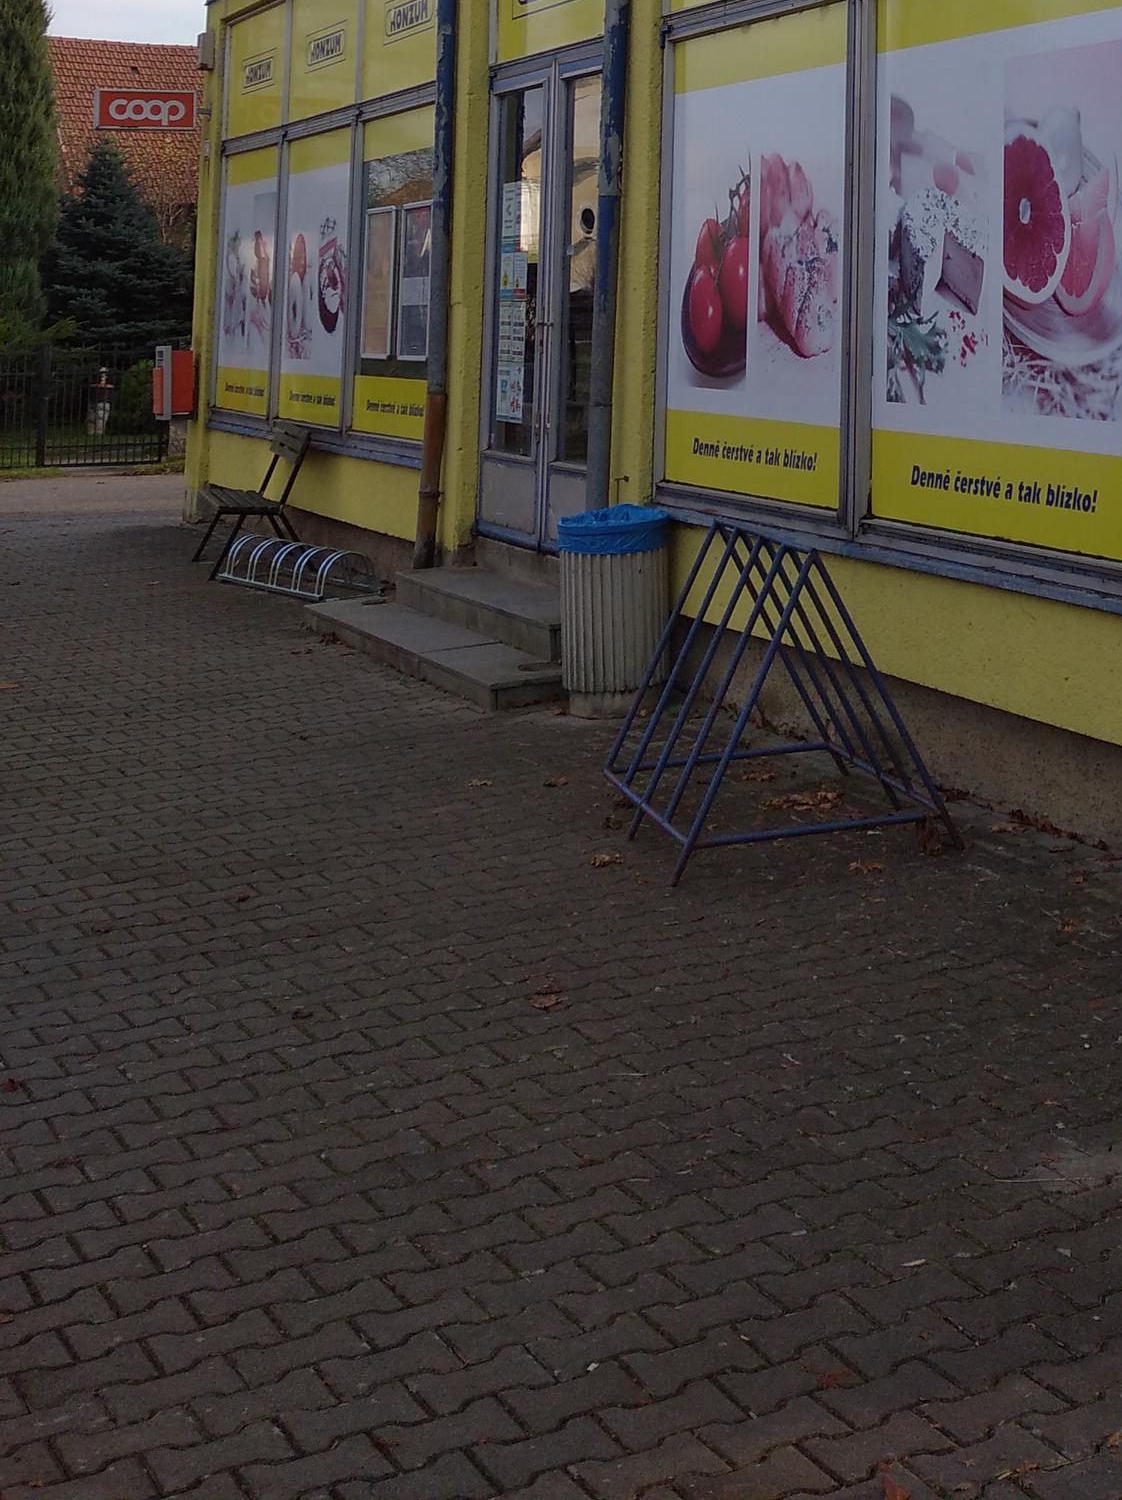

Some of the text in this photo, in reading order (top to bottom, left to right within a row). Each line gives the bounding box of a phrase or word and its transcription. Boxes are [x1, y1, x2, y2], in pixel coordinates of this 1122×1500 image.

[108, 99, 185, 126] coop
[756, 449, 762, 464] a
[764, 448, 781, 466] tak
[1005, 480, 1013, 500] a
[1018, 481, 1041, 505] tak
